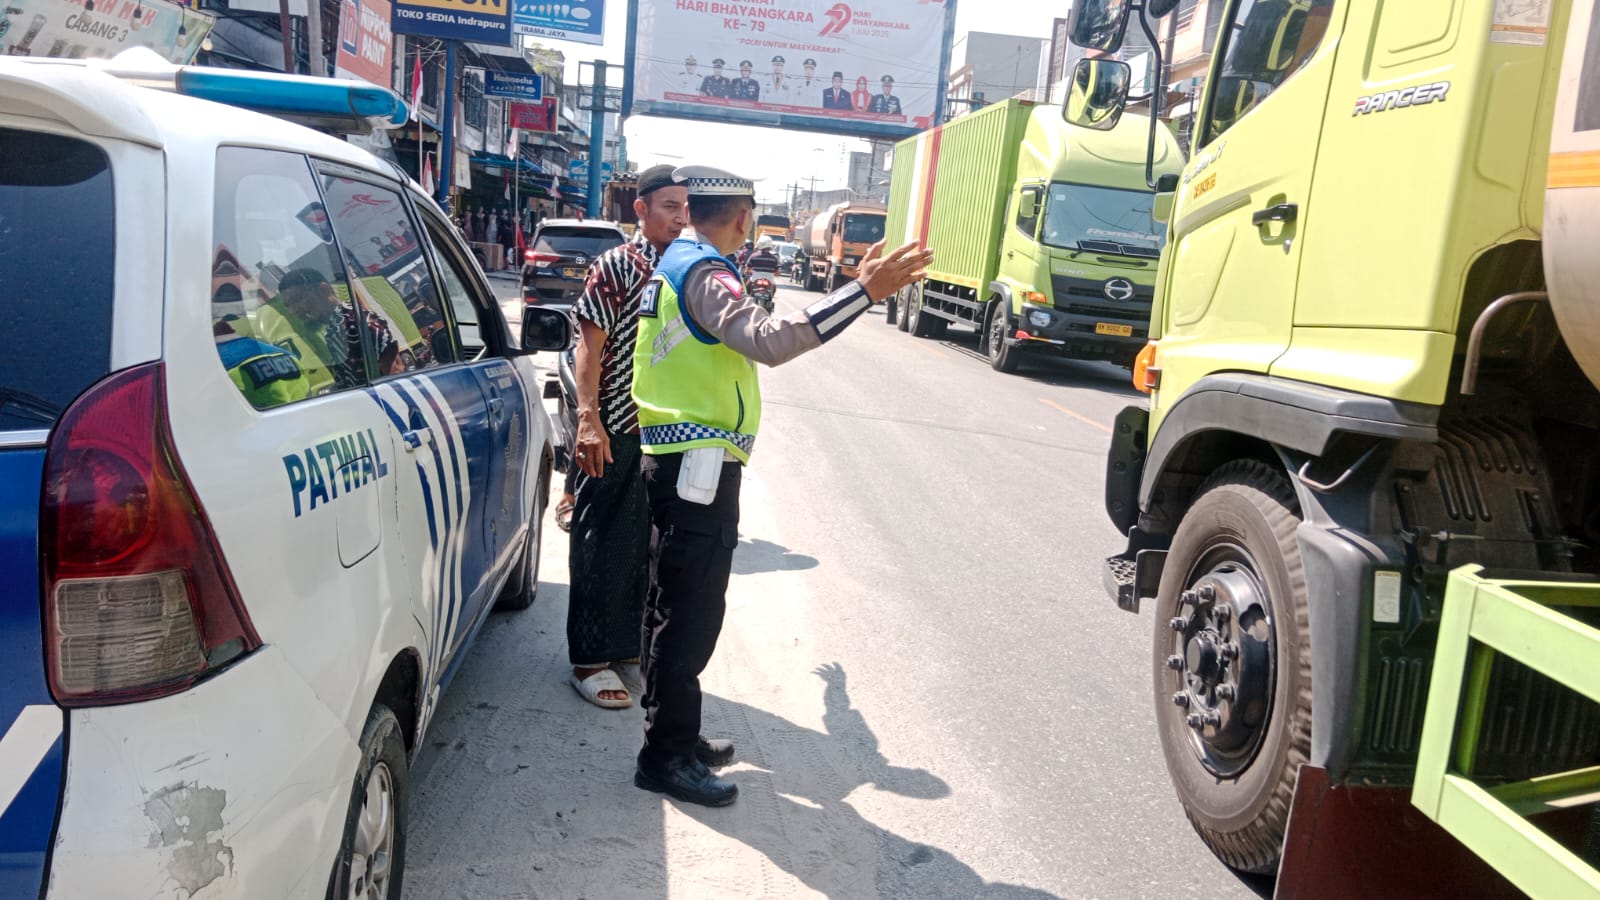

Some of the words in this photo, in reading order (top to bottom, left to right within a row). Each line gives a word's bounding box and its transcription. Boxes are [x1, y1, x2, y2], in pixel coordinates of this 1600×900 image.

[361, 4, 391, 45] NIPPON
[396, 9, 424, 19] TOKO
[425, 12, 456, 23] SEDIA
[457, 16, 506, 29] Indrapura
[676, 0, 708, 12] HARI
[711, 3, 813, 23] BHAYANGKARA
[751, 20, 766, 31] 79
[65, 14, 118, 40] CABANG
[118, 29, 128, 42] 3
[547, 30, 567, 38] JAYA
[362, 33, 386, 67] PAINT
[1351, 81, 1451, 117] RANGER
[282, 428, 388, 518] PATWAL
